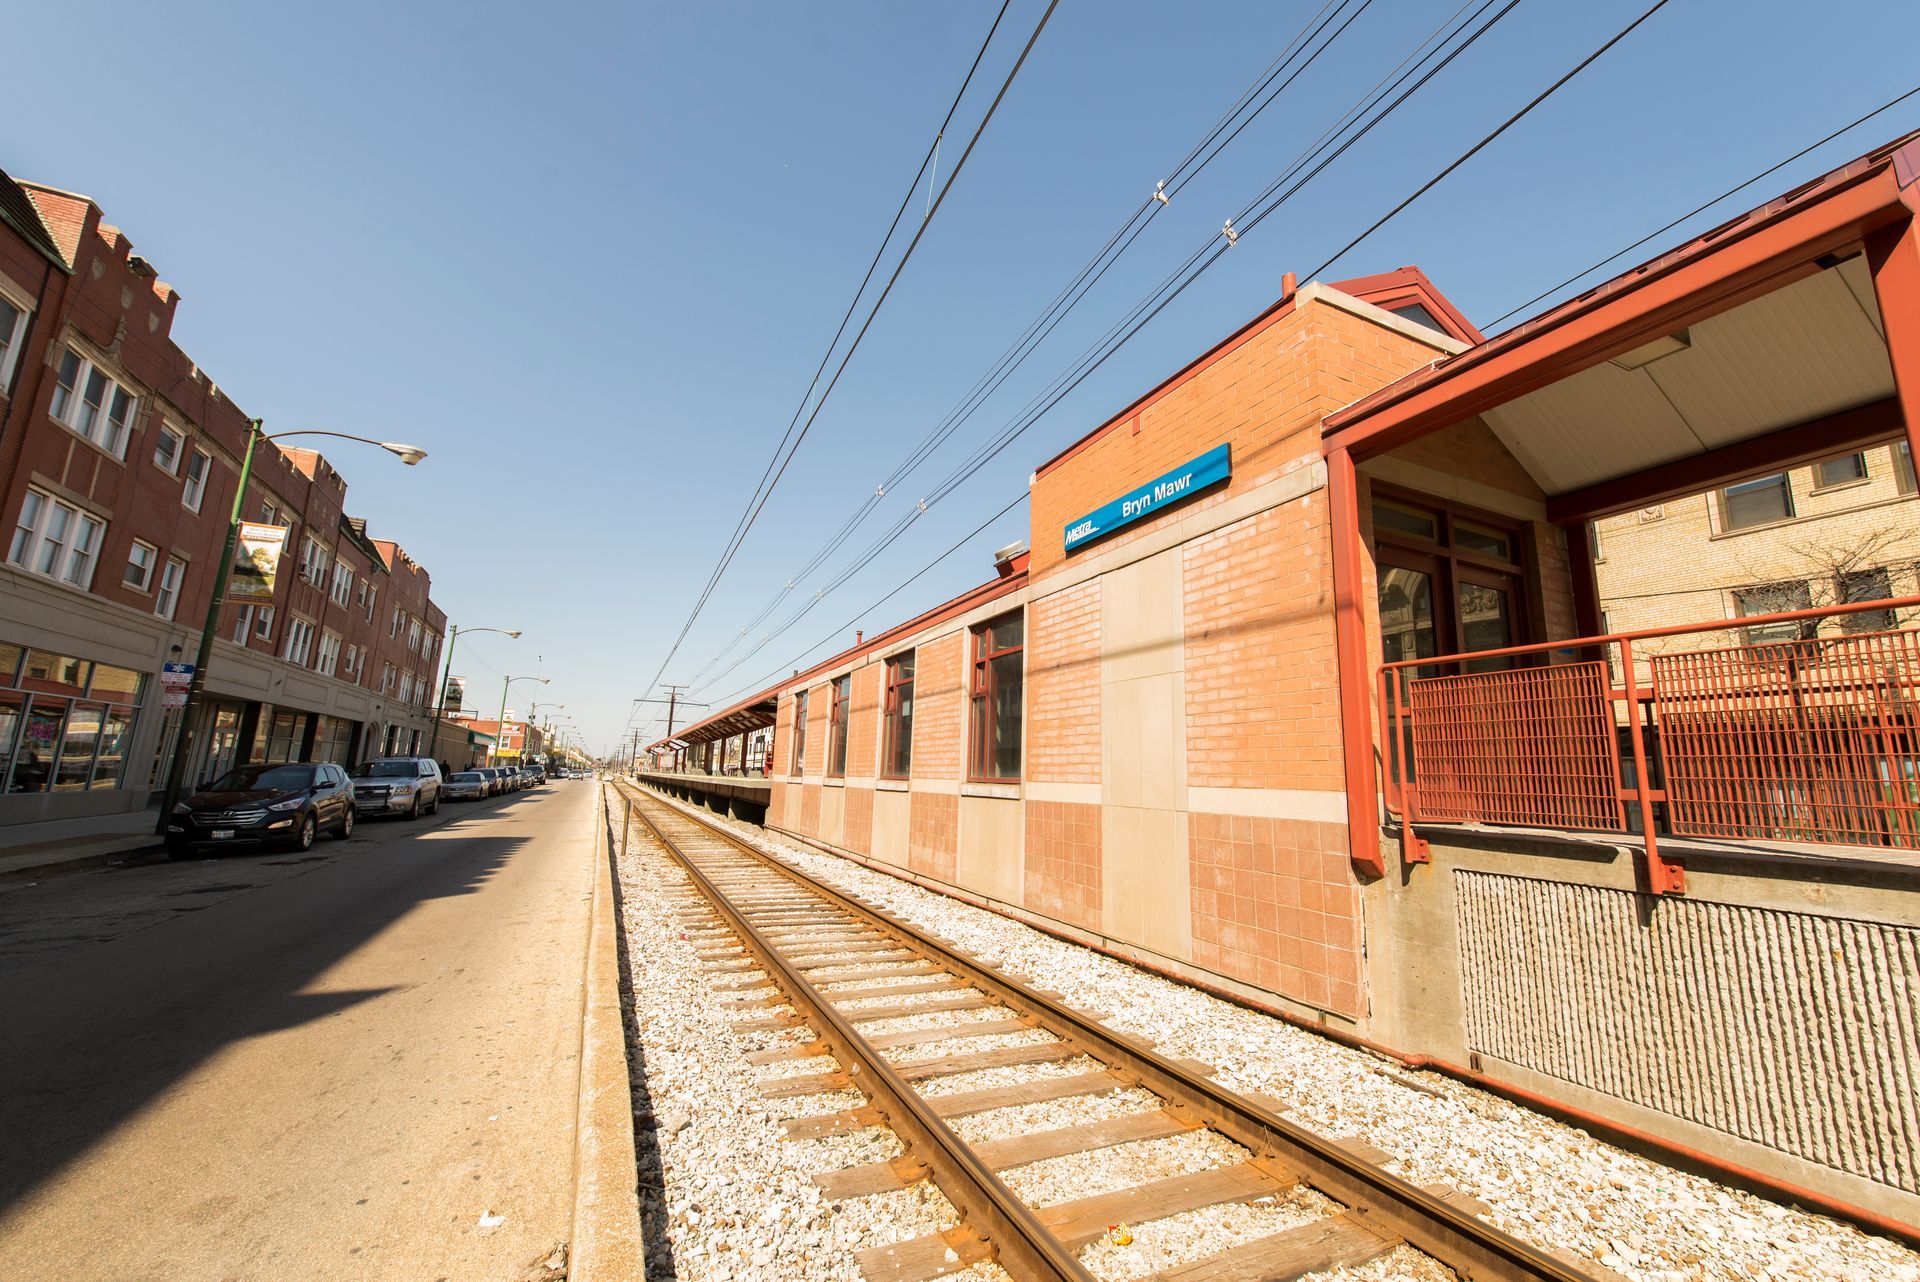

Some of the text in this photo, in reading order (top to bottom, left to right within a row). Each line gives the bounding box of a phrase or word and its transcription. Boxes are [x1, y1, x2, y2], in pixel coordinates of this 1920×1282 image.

[1122, 472, 1193, 518] Bryn Mawr
[1065, 520, 1099, 545] Metra
